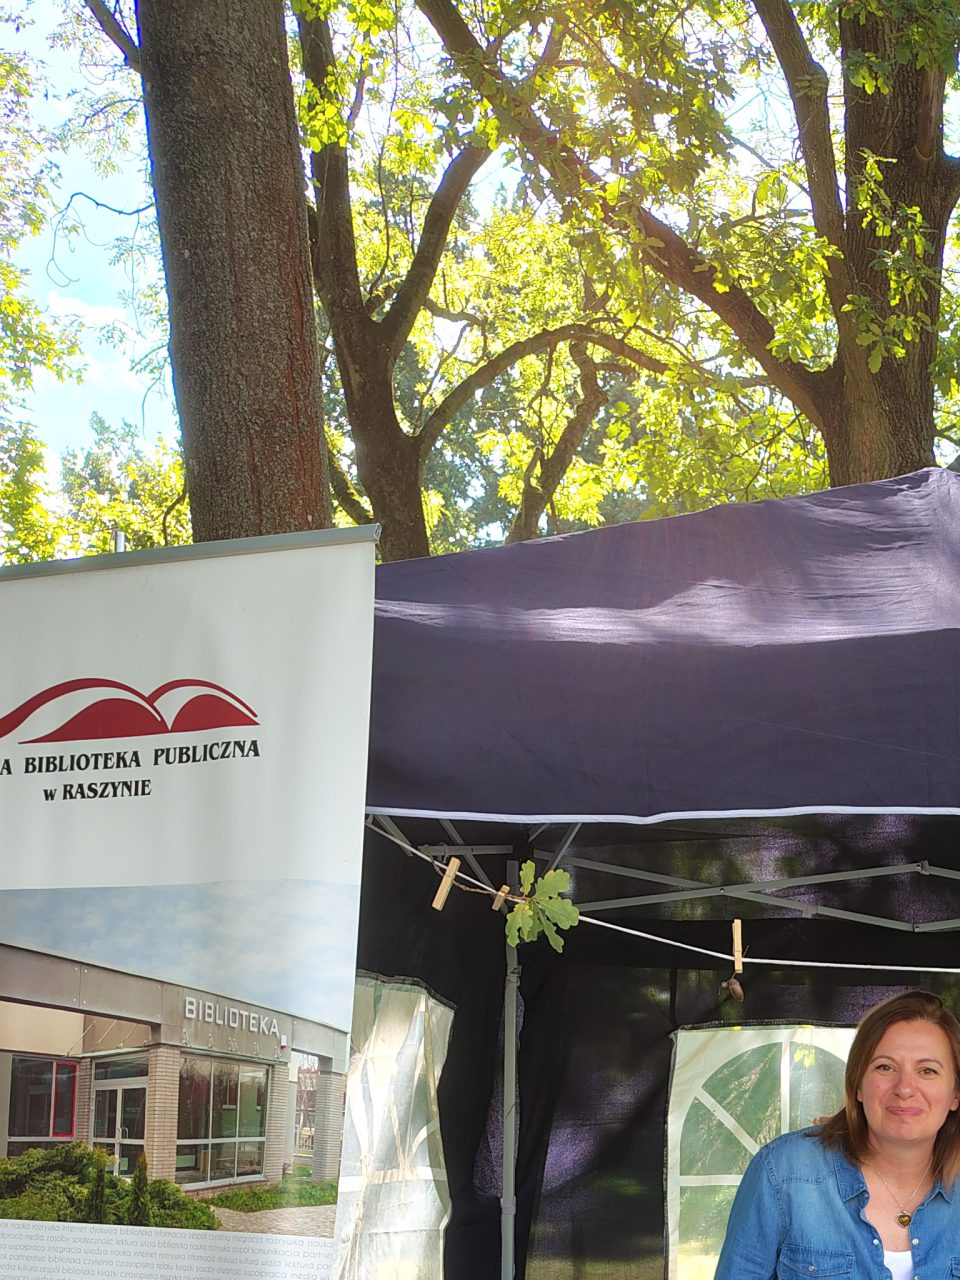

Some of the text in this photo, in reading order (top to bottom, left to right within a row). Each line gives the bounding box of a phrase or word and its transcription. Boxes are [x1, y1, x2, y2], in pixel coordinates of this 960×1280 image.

[24, 750, 141, 773] BIBLIOTEKA
[153, 740, 260, 766] PUBLICZNA
[43, 780, 152, 801] w RASZYNIE
[185, 996, 280, 1037] BIBLIOTEKA
